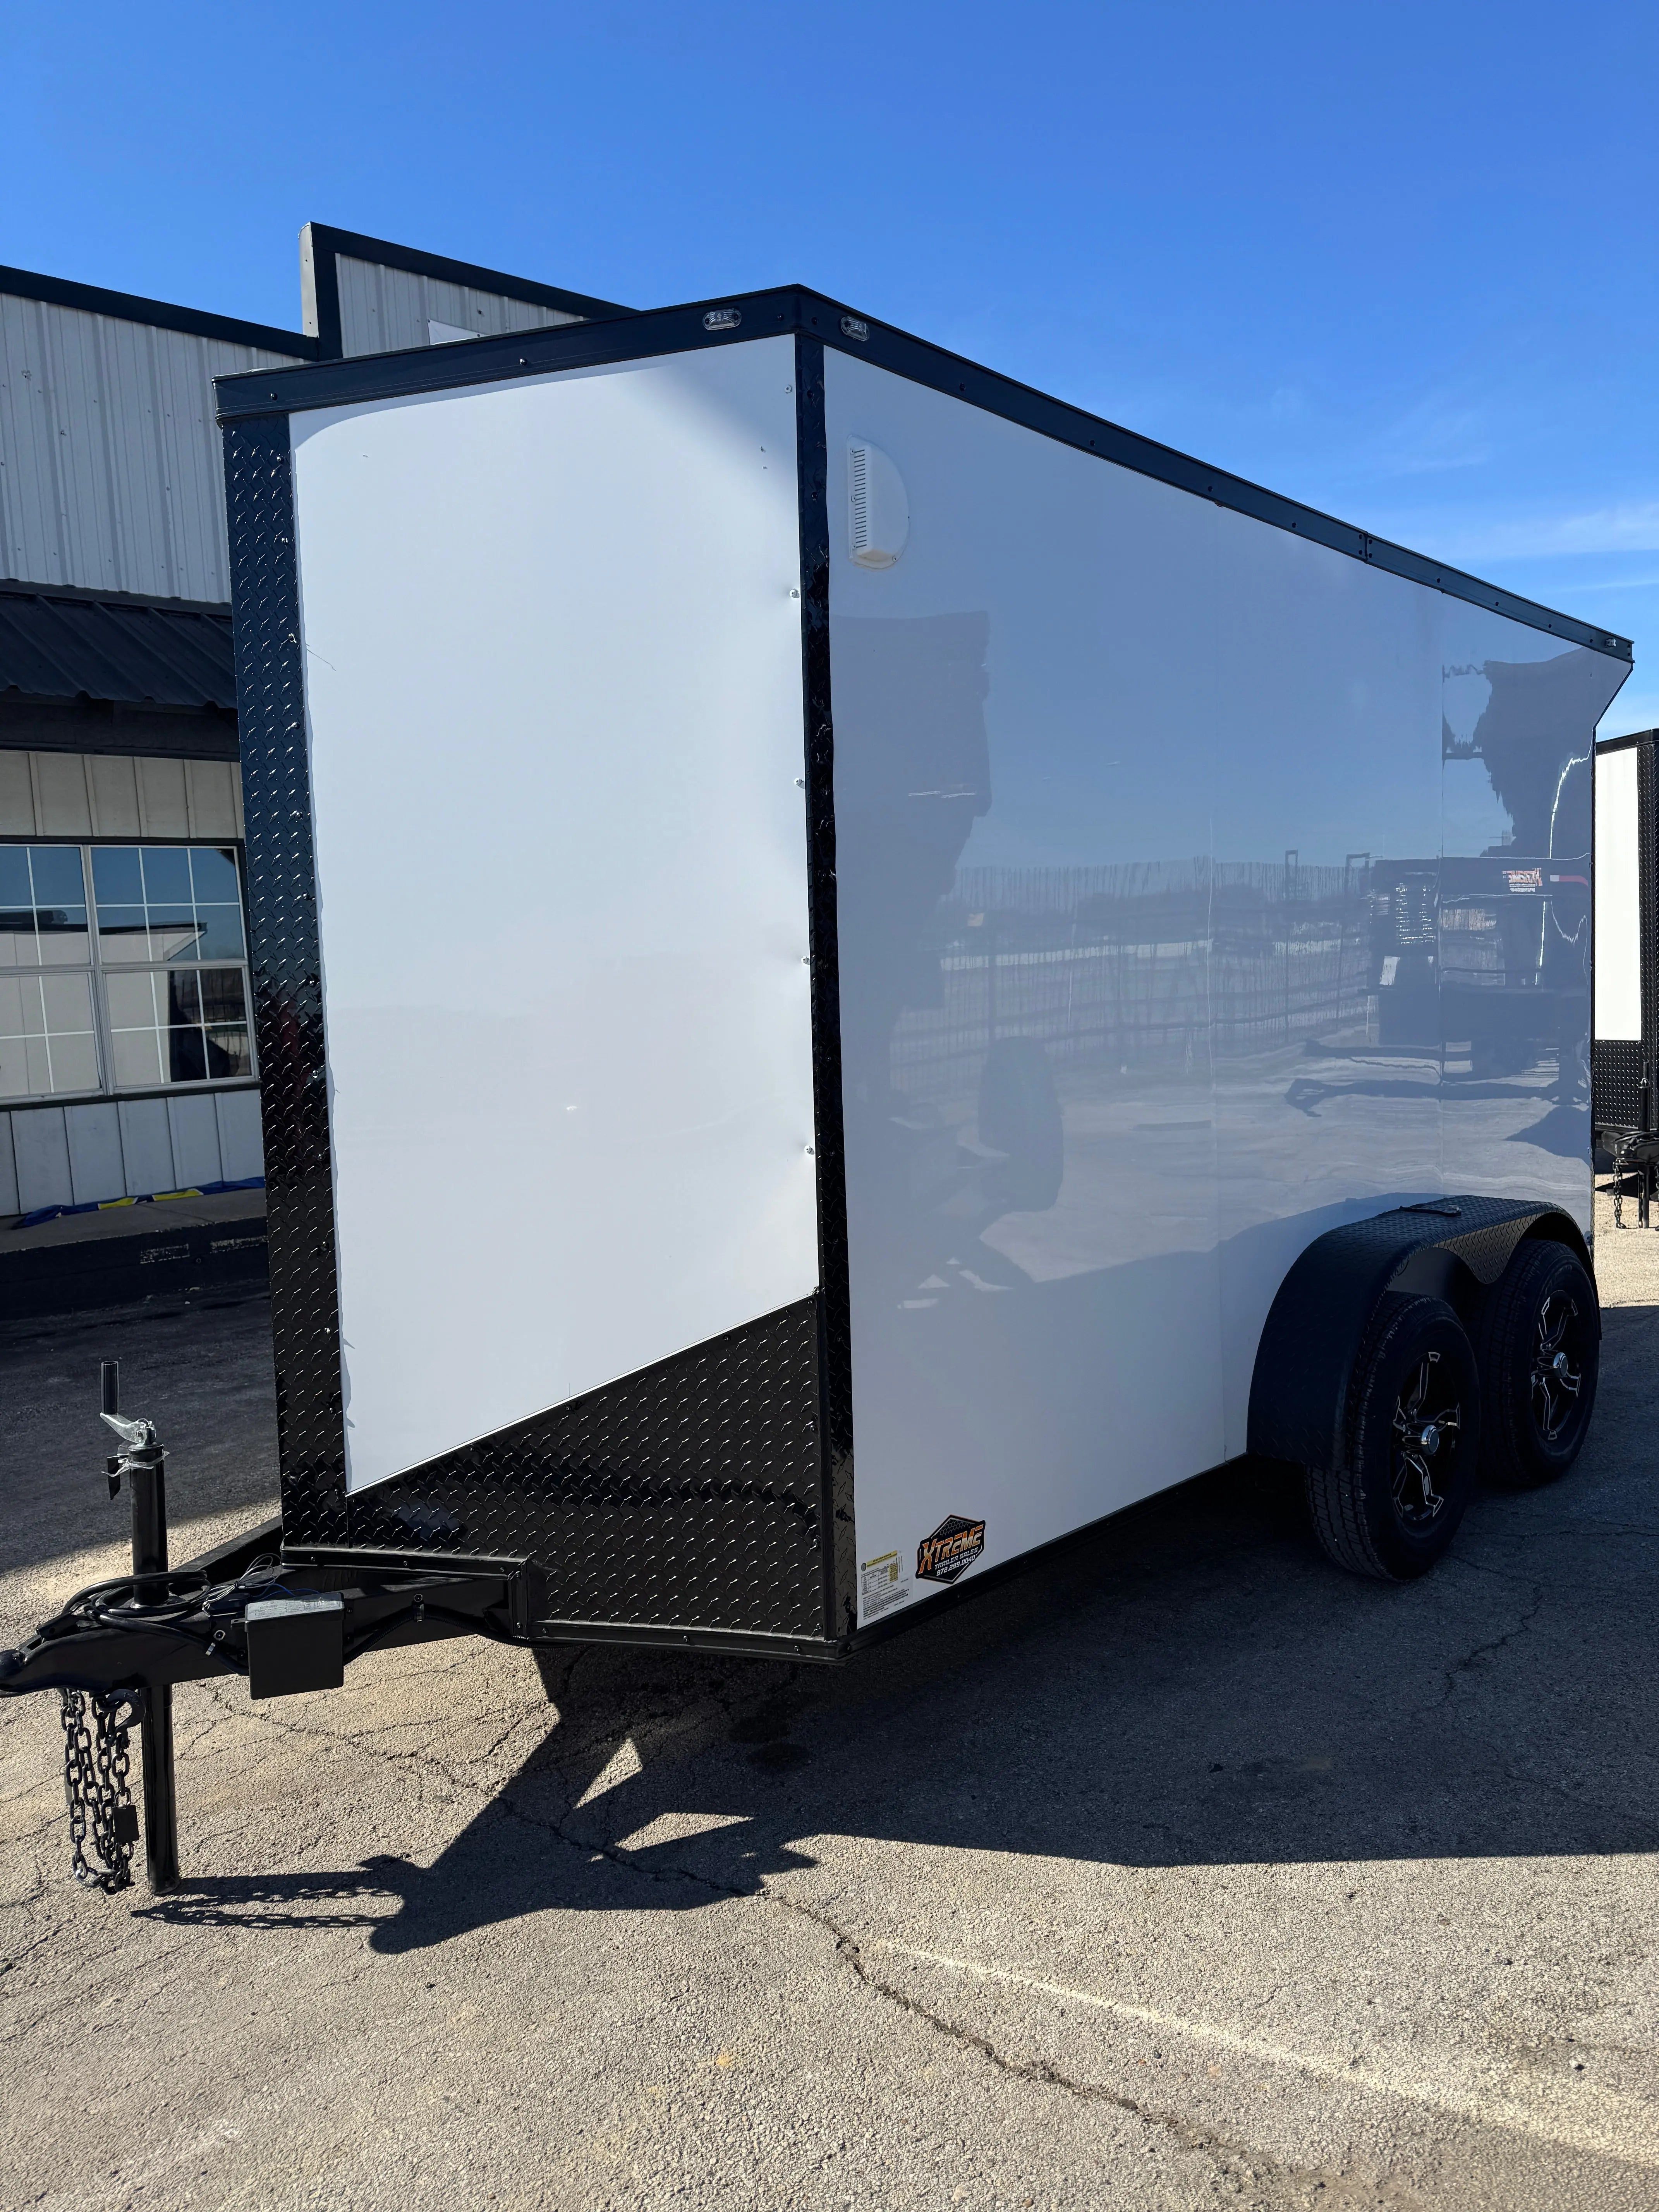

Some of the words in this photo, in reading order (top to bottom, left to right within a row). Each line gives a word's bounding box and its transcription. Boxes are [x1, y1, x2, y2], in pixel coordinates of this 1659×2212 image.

[918, 1524, 984, 1575] XTREME
[934, 1556, 958, 1570] TRAILER
[959, 1547, 979, 1559] SALES
[936, 1554, 975, 1577] 972.299.0040
